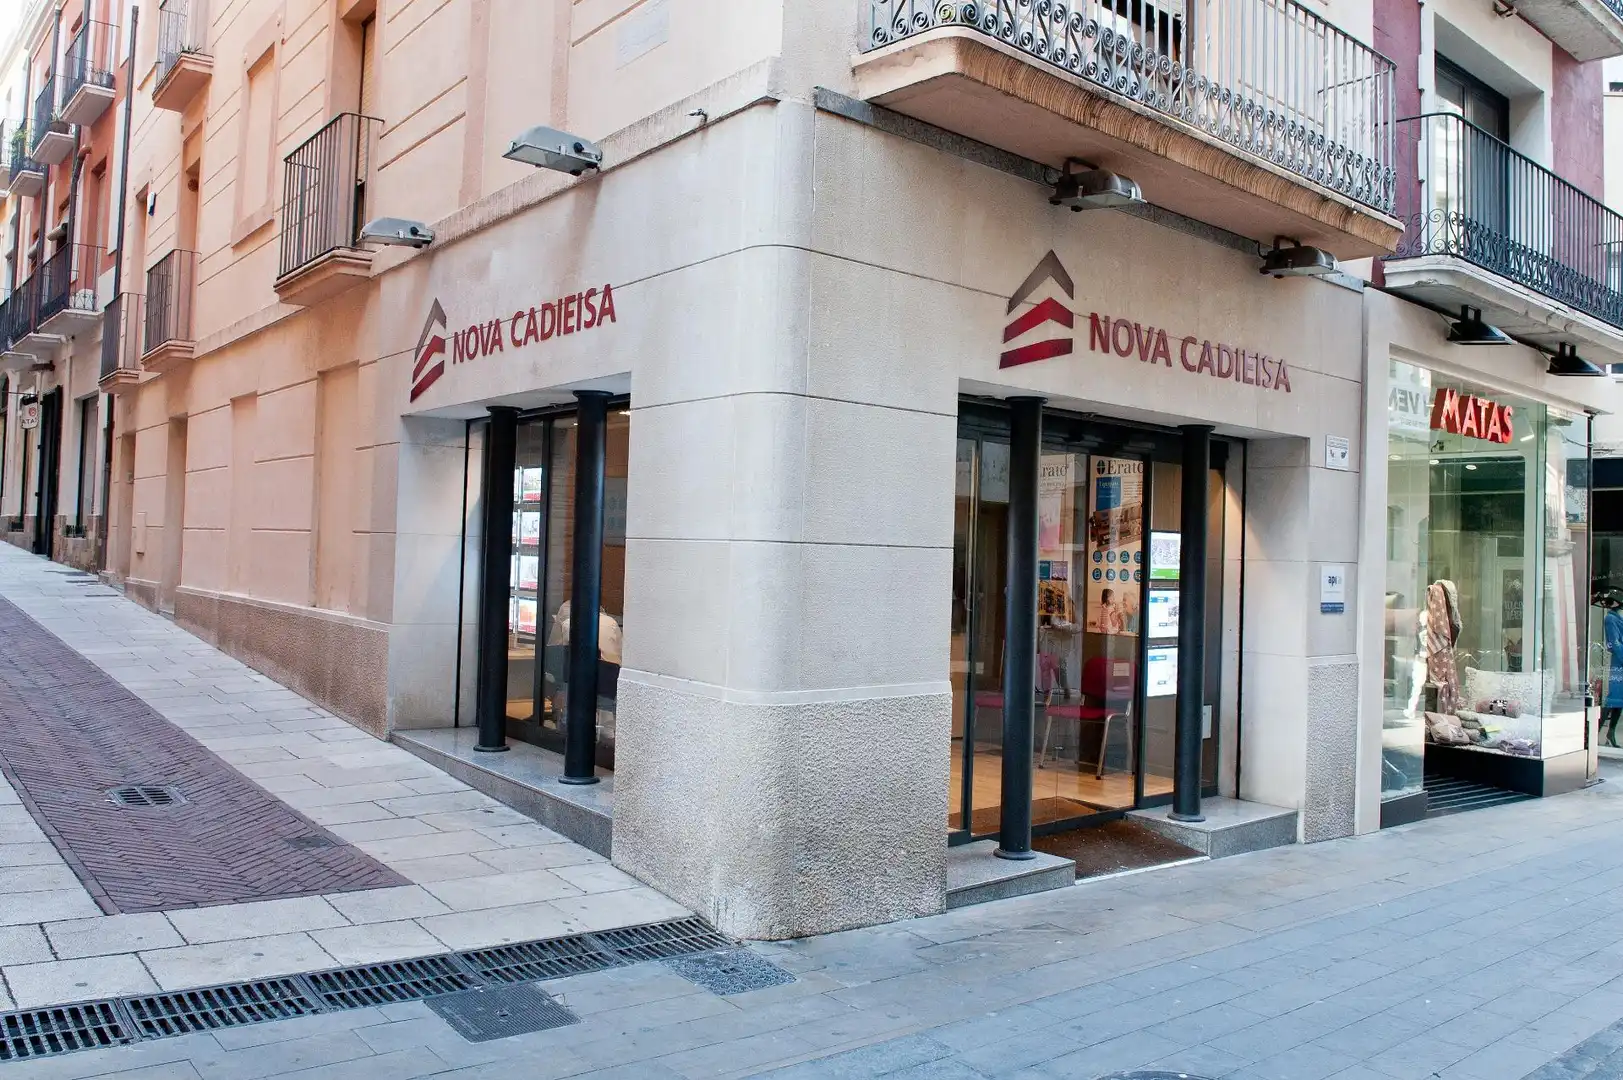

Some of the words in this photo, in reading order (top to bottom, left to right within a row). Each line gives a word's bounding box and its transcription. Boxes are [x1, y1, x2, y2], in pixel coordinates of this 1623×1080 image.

[453, 318, 504, 365] NOVA
[510, 283, 617, 348] CADIEISA
[1090, 312, 1172, 368] NOVA
[1180, 335, 1291, 393] CADIEISA
[1434, 387, 1514, 444] MATAS
[1041, 464, 1068, 477] rato
